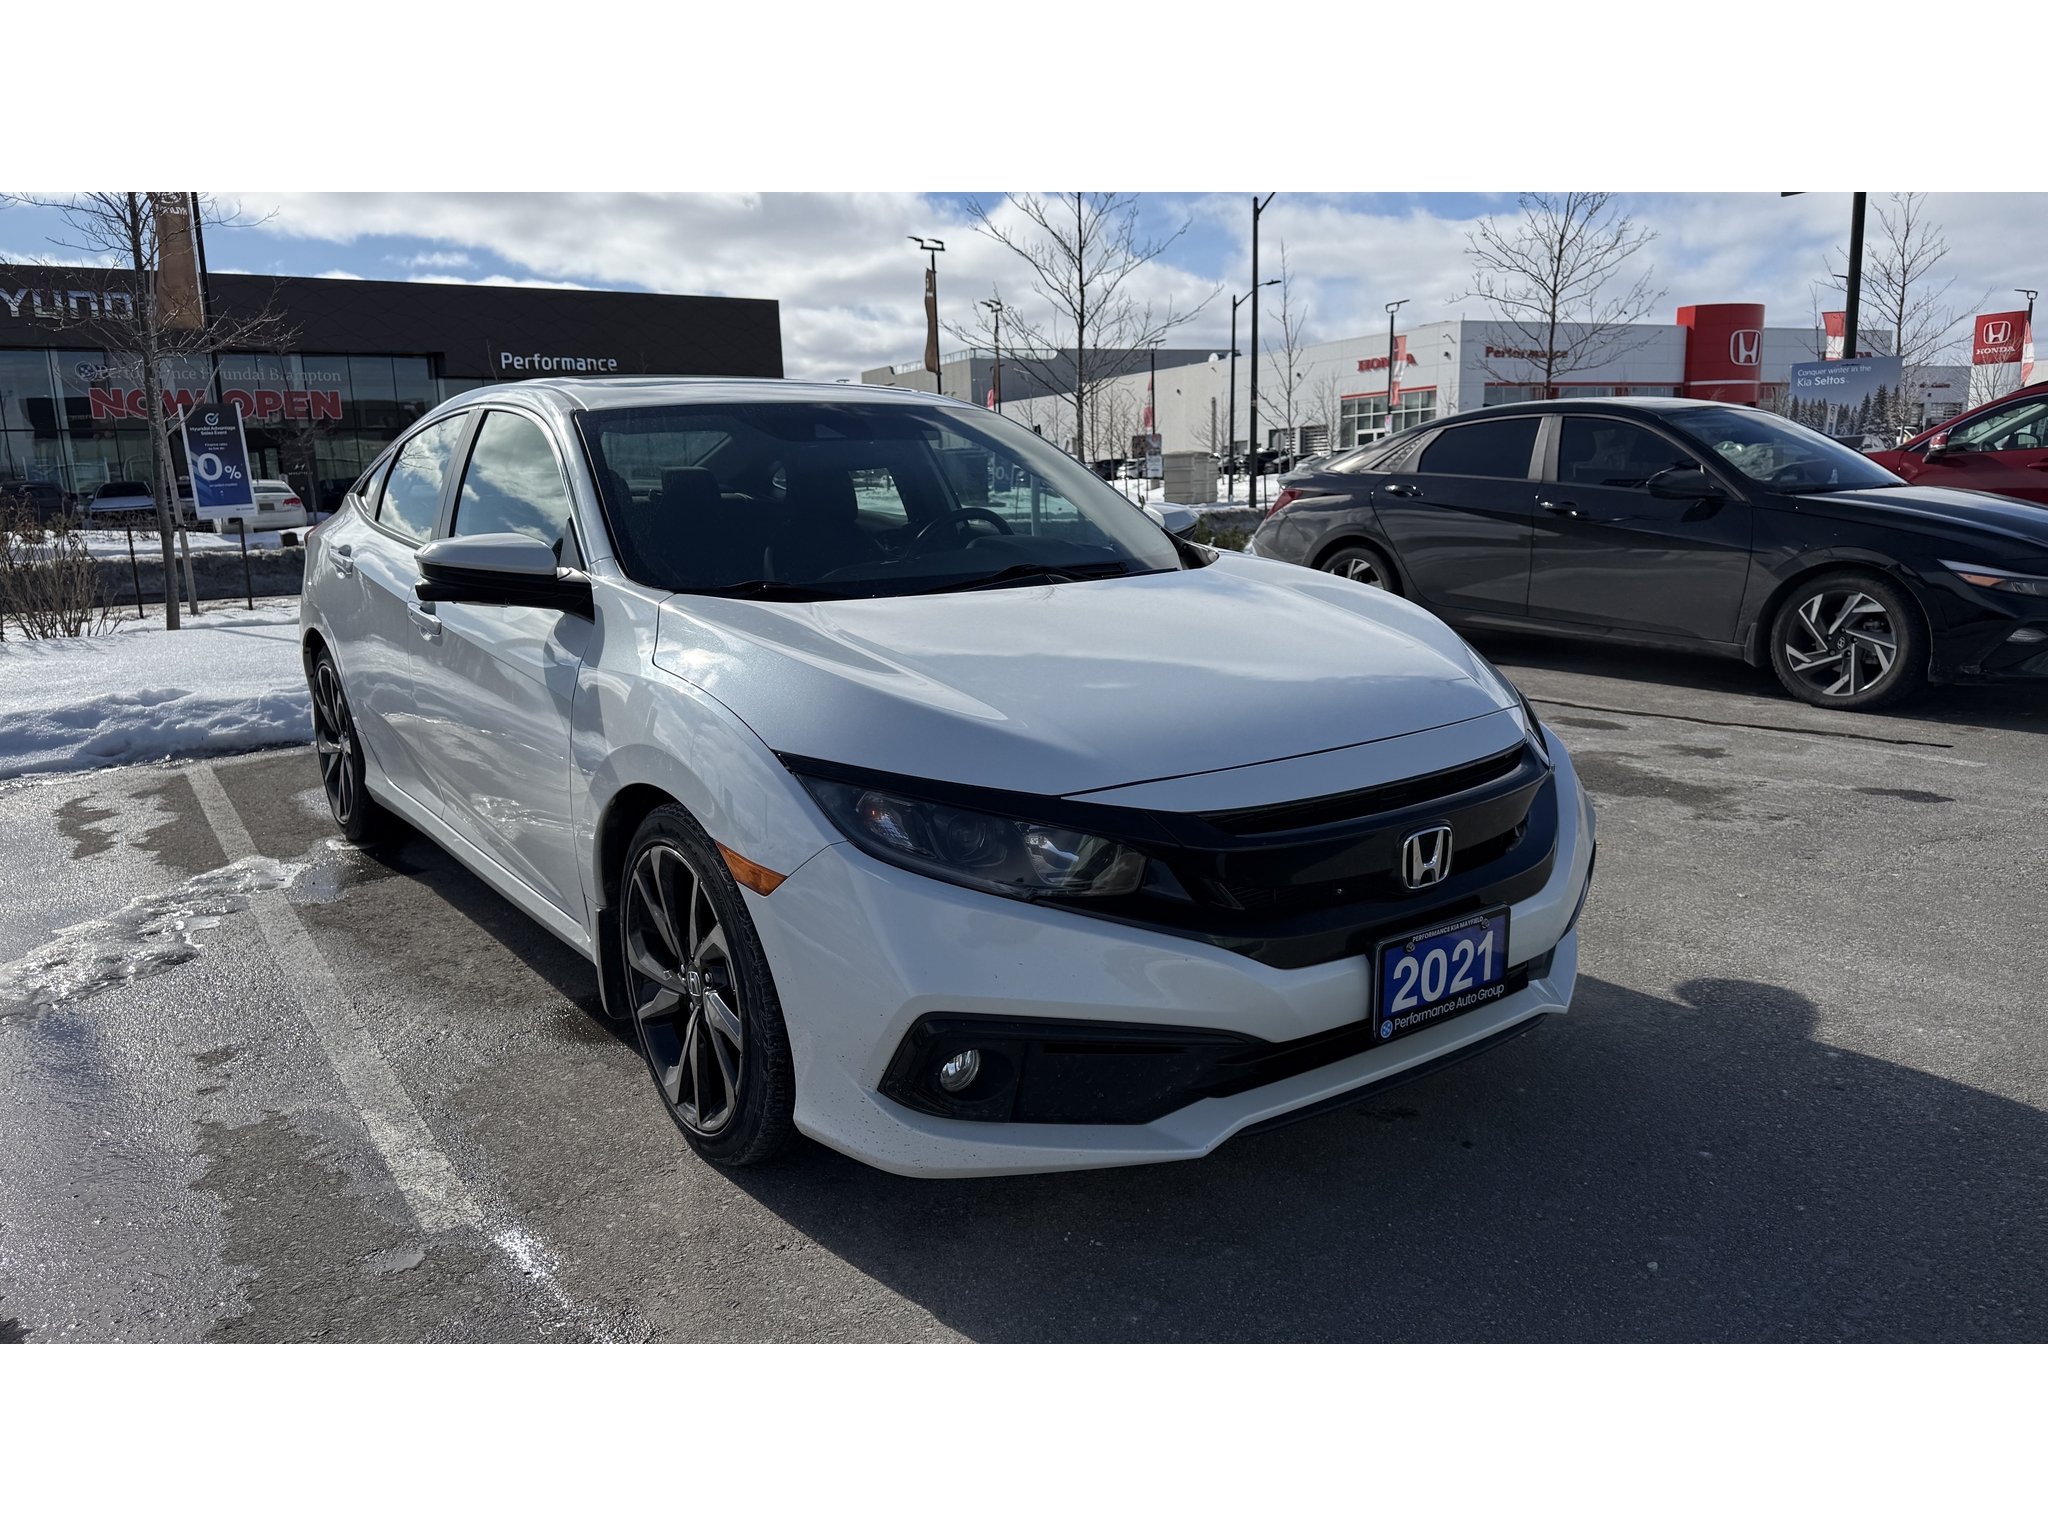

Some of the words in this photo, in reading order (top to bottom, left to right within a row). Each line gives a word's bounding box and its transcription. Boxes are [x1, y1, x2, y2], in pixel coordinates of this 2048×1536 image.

[0, 288, 134, 320] YUND
[1485, 346, 1568, 359] Performace
[1976, 346, 2016, 355] HONDA
[500, 352, 617, 371] Performance
[1357, 353, 1418, 371] HONA
[1797, 368, 1826, 377] Conquer
[1828, 365, 1849, 375] winter
[1851, 365, 1858, 373] in
[200, 366, 265, 382] Hundai
[269, 367, 342, 385] Brampton
[1797, 378, 1811, 387] Kia
[88, 388, 208, 419] NOW
[221, 389, 343, 419] OPEN
[1412, 925, 1451, 943] PERFORMANCE
[1450, 923, 1460, 932] KIA
[1459, 915, 1484, 929] MAYFIELD
[1391, 930, 1494, 1013] 2021
[1394, 1000, 1455, 1030] Performance
[1456, 992, 1477, 1009] Auto
[1478, 983, 1504, 1001] Group
